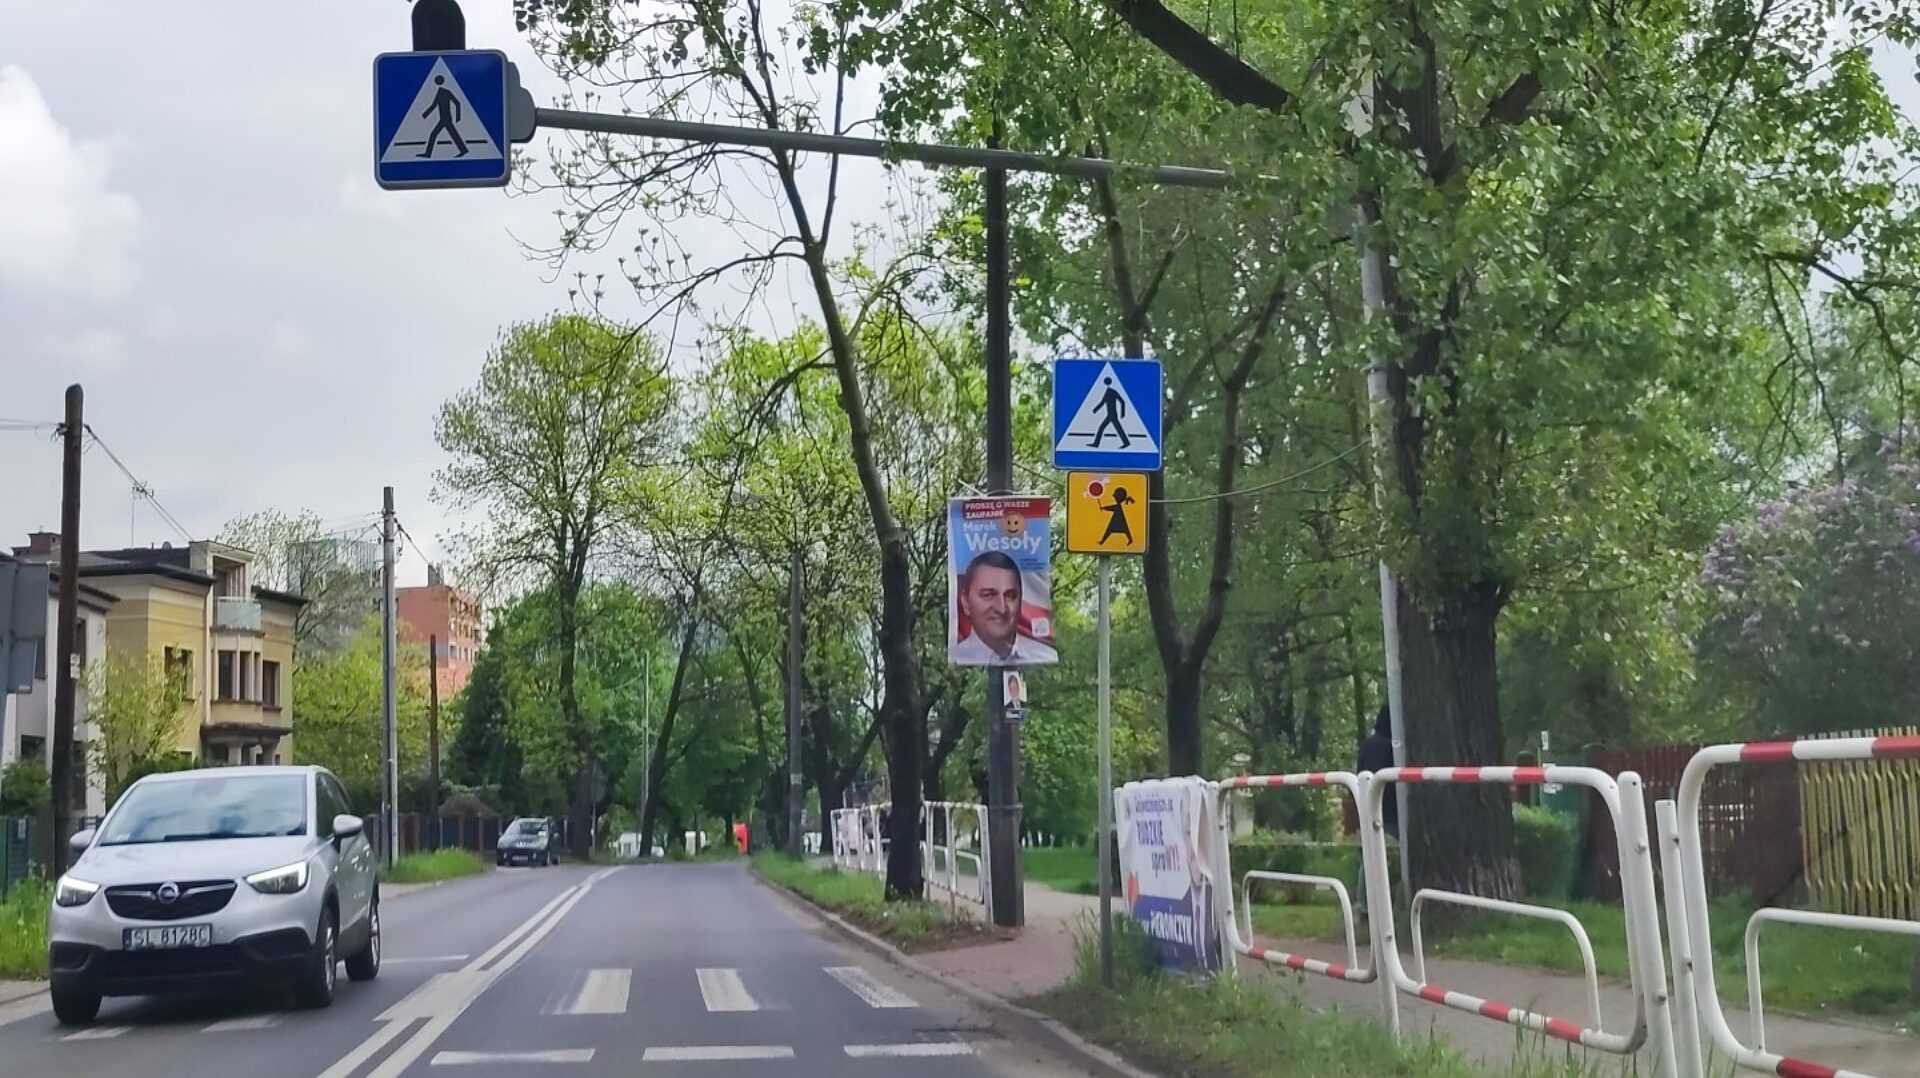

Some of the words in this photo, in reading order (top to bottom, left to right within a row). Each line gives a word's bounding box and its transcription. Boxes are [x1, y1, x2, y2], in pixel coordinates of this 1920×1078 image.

[963, 522, 997, 532] Marek
[965, 531, 1042, 554] Wesoły
[133, 929, 153, 945] SL
